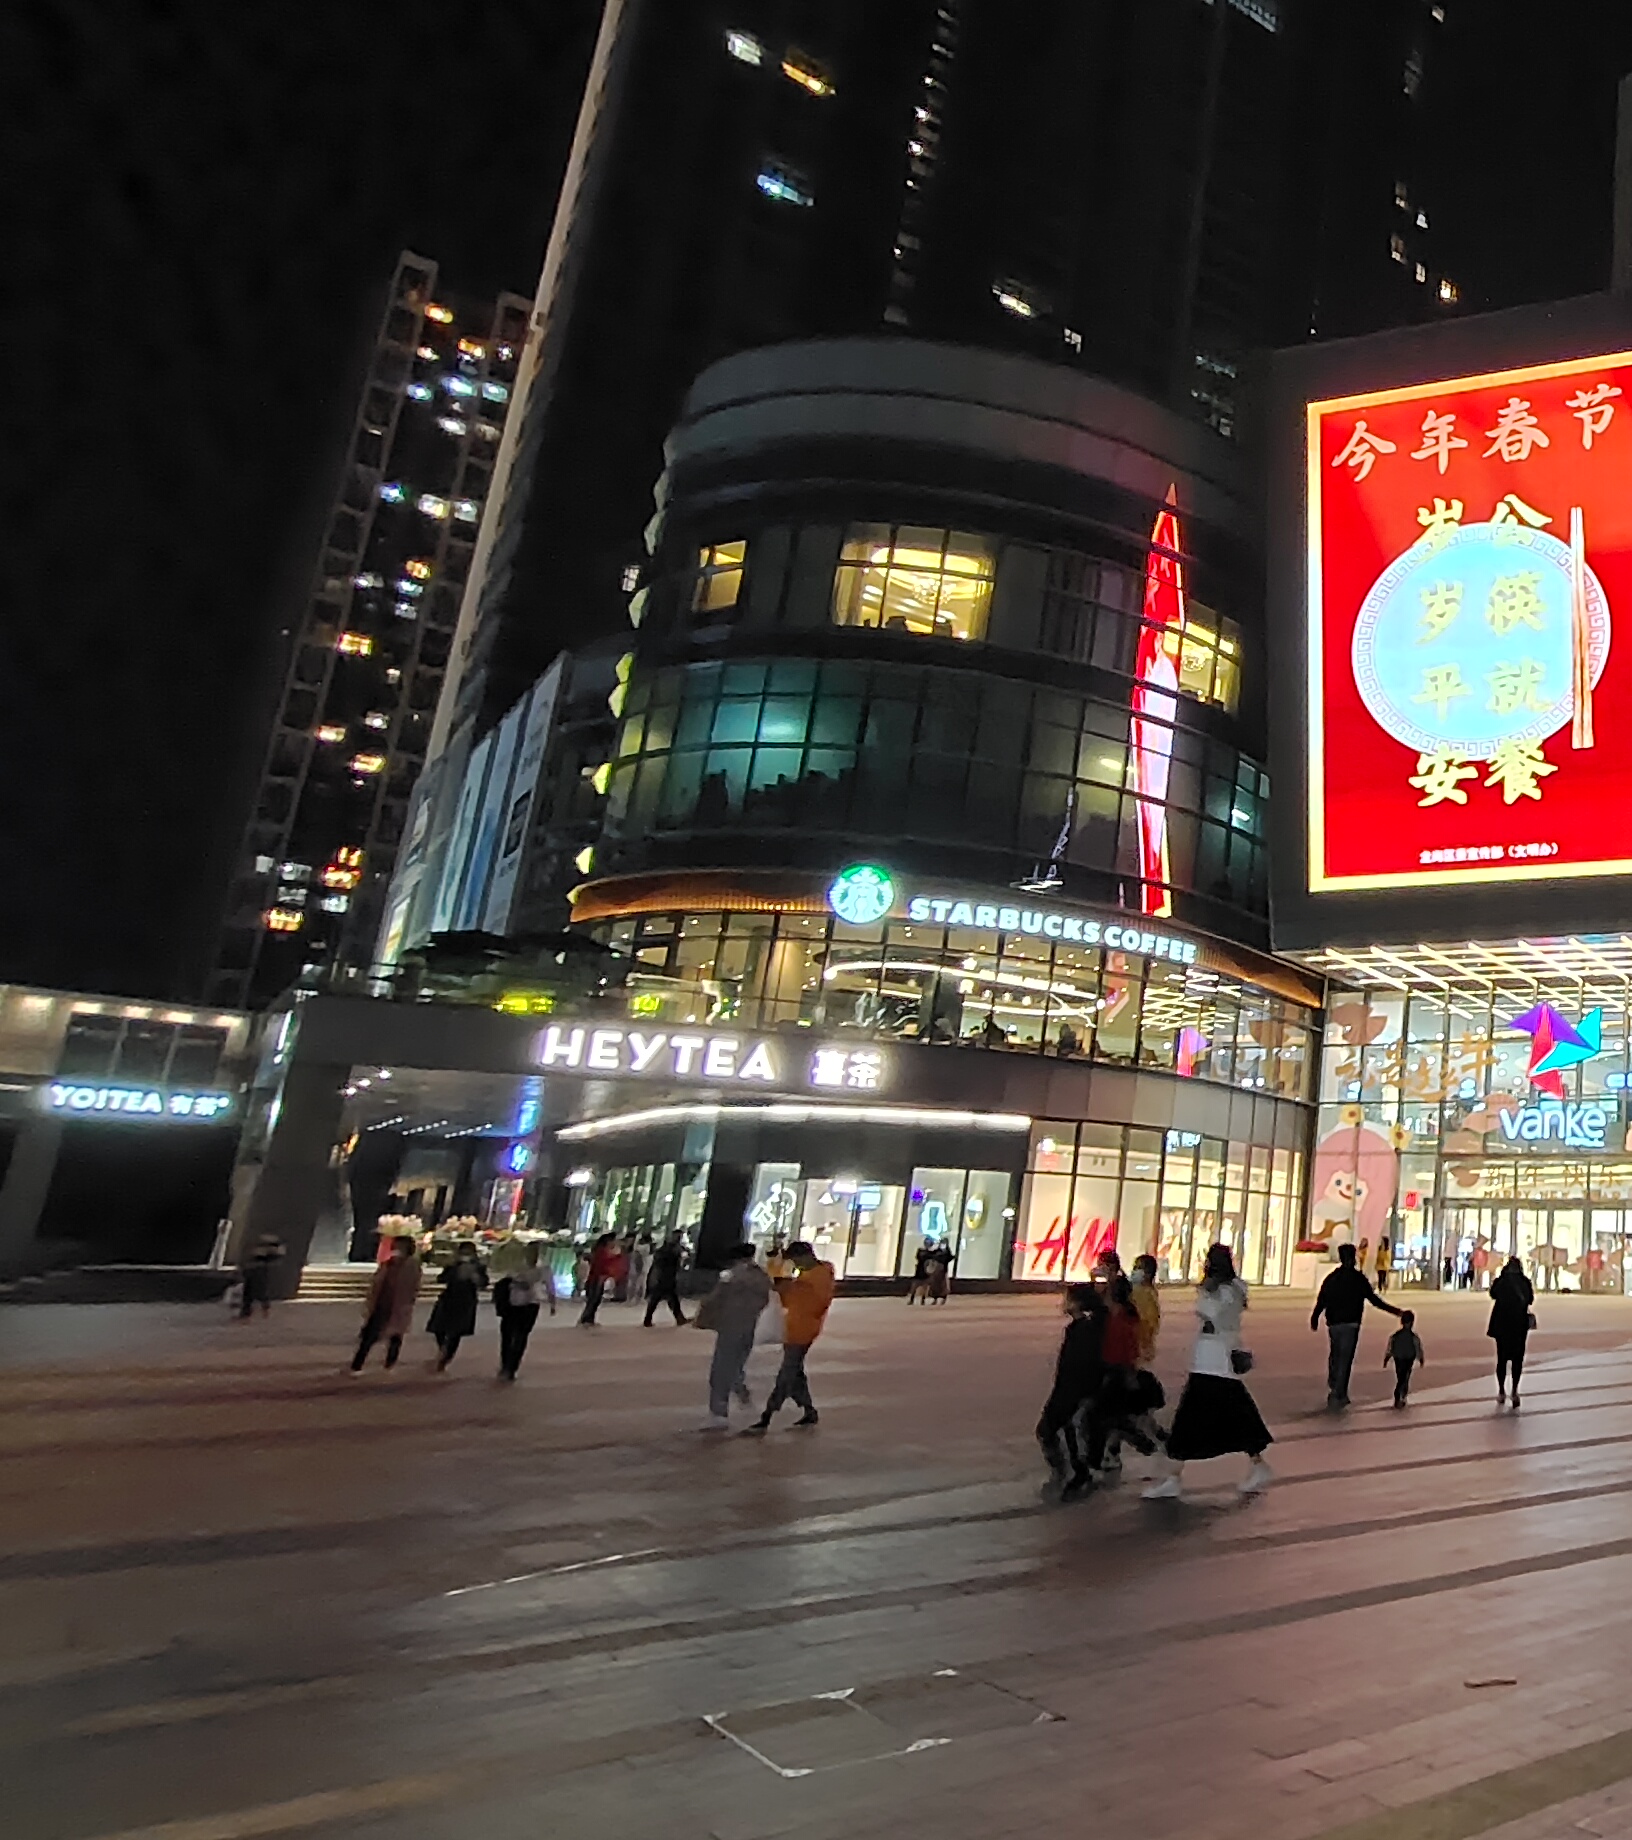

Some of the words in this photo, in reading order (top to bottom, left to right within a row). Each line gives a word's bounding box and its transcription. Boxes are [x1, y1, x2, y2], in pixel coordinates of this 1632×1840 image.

[1332, 383, 1622, 482] 今年春节
[1409, 497, 1478, 806] 岁岁平安
[1484, 494, 1558, 805] 公筷就餐
[909, 896, 1101, 944] STARBUCKS
[1103, 924, 1197, 964] COFFEE
[540, 1025, 778, 1081] HEYTEA
[812, 1049, 881, 1088] 喜茶
[1499, 1105, 1607, 1140] vanke
